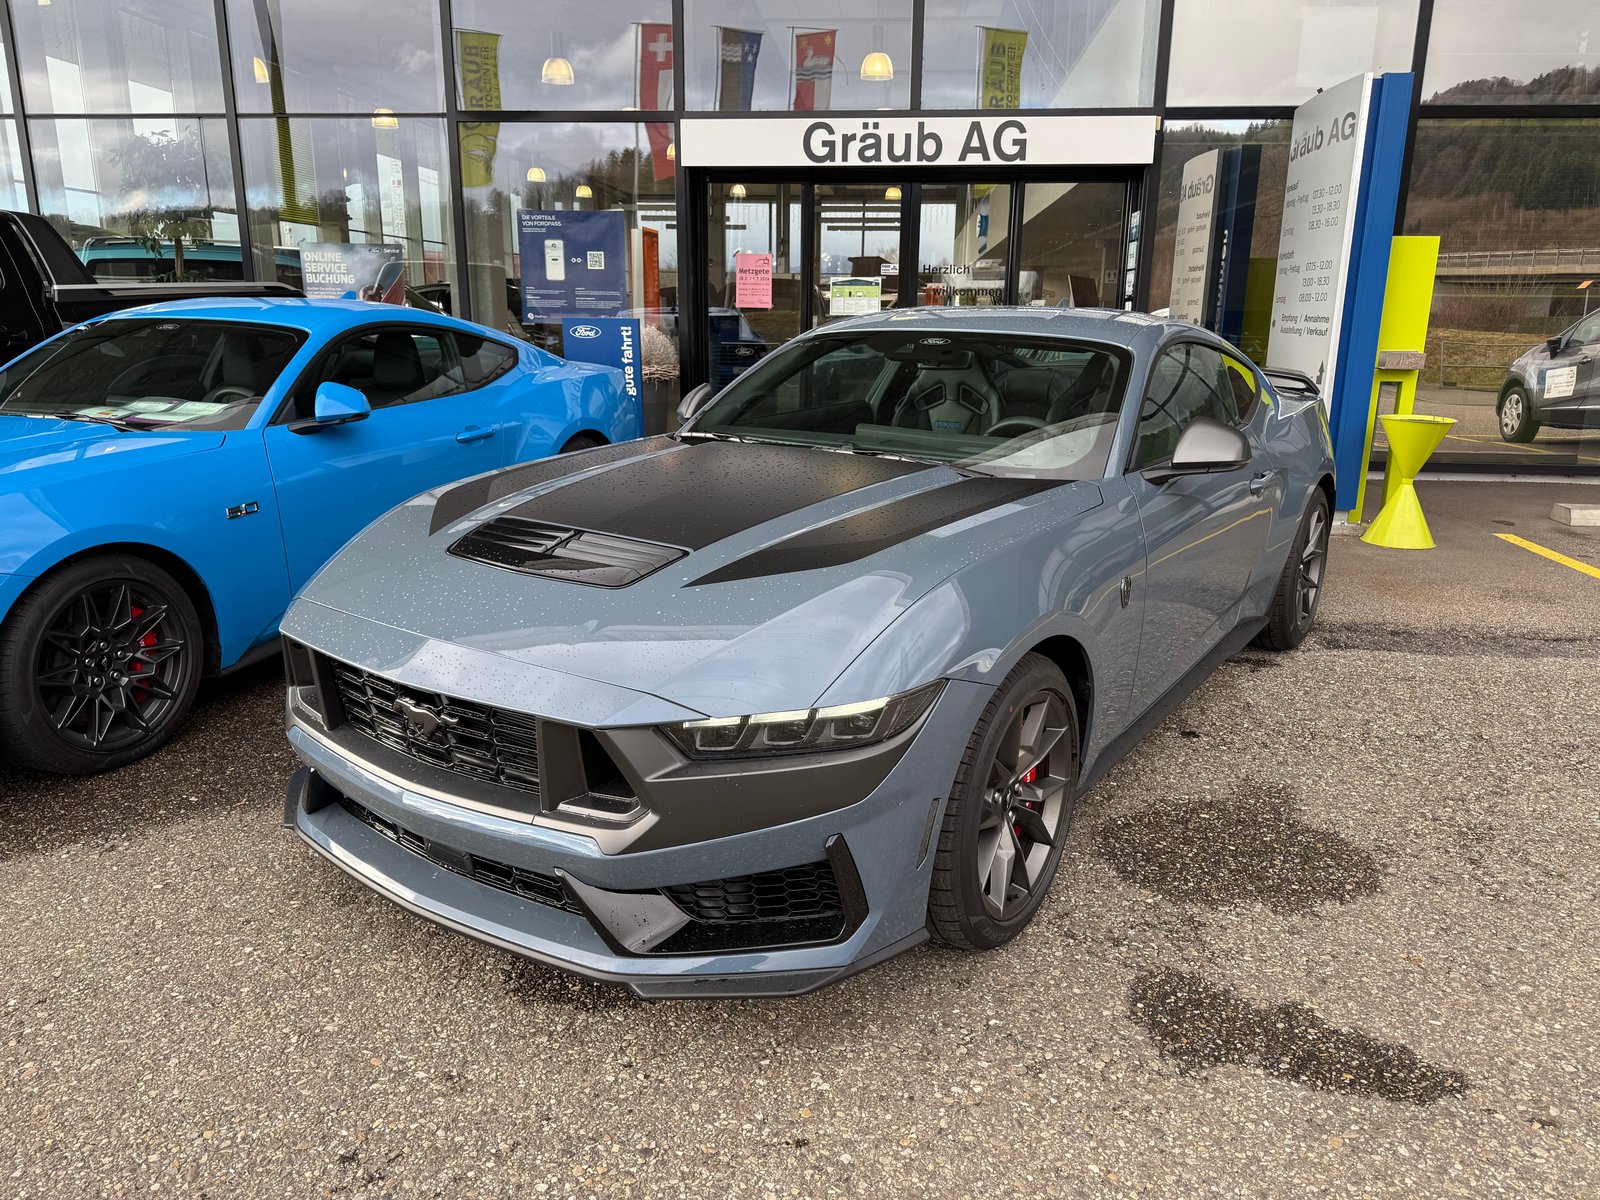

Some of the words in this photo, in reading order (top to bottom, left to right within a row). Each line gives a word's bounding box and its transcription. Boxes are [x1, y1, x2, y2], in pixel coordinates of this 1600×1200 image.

[1327, 111, 1357, 146] AG
[803, 121, 943, 164] Gräub
[957, 119, 1028, 163] AG
[303, 251, 342, 262] ONLINE
[304, 262, 347, 273] SERVICE
[738, 267, 770, 276] Metzgete
[922, 264, 971, 275] Herzlich
[305, 274, 355, 284] BUCHUNG
[932, 287, 1002, 297] willkommen
[1281, 313, 1298, 324] Empfang
[1304, 314, 1330, 323] Annahme
[573, 326, 598, 337] Ford
[1306, 327, 1329, 336] Verkauf
[620, 326, 633, 364] fahrt!
[625, 366, 637, 396] gute
